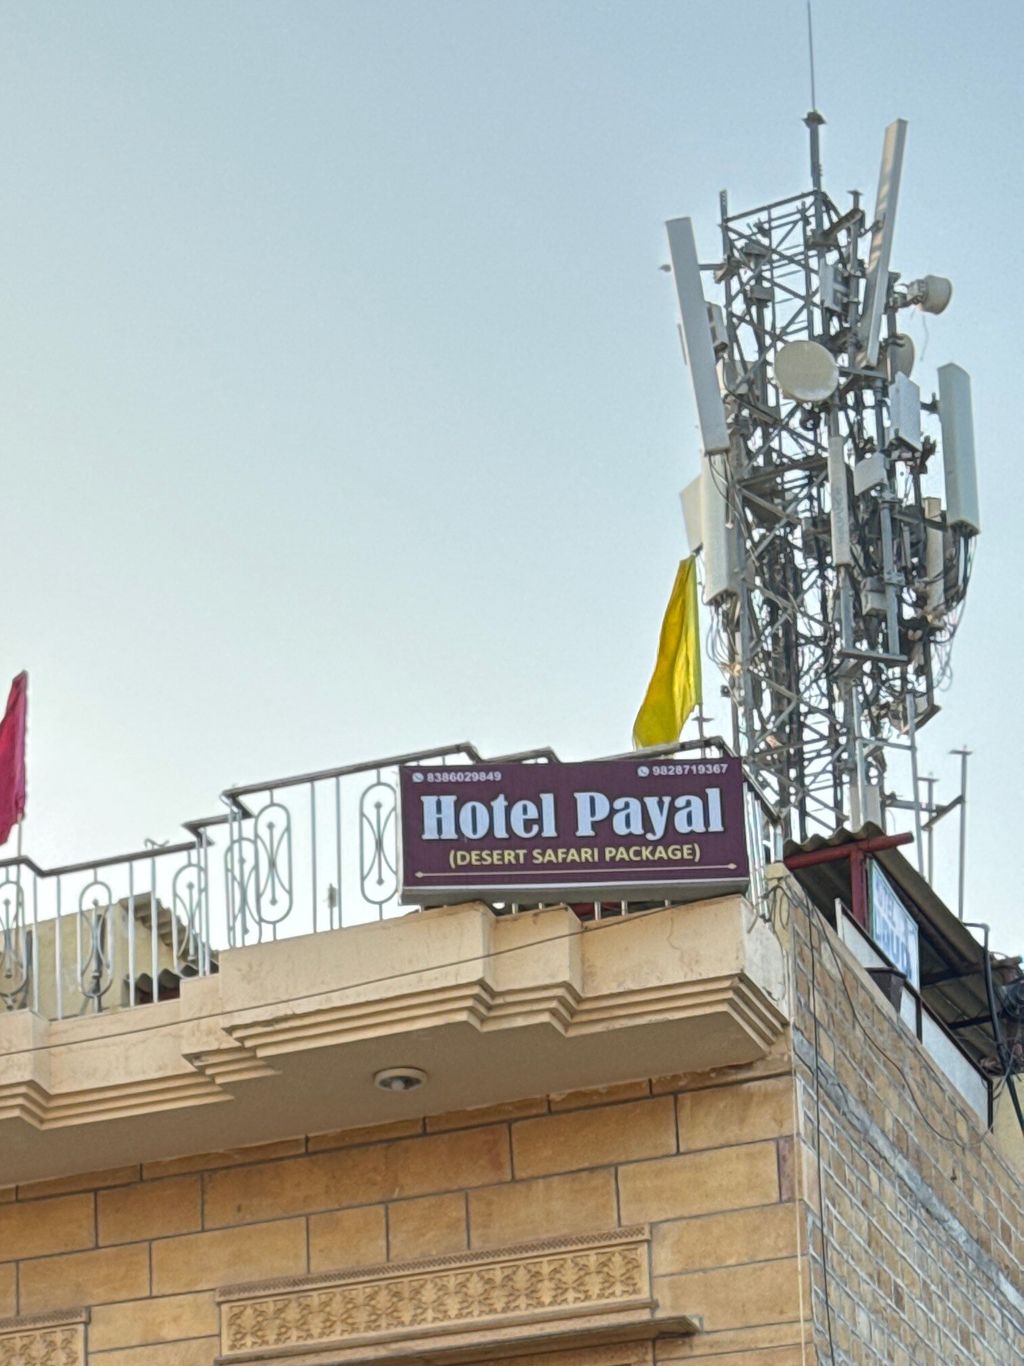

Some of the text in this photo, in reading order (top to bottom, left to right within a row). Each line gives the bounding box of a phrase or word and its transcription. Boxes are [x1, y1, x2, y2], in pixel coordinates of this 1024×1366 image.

[426, 770, 502, 783] 8386029849
[652, 763, 729, 776] 9828719367
[420, 787, 724, 841] Hotel Payal
[449, 843, 701, 869] (DESERT SAFARI PACKAGE)
